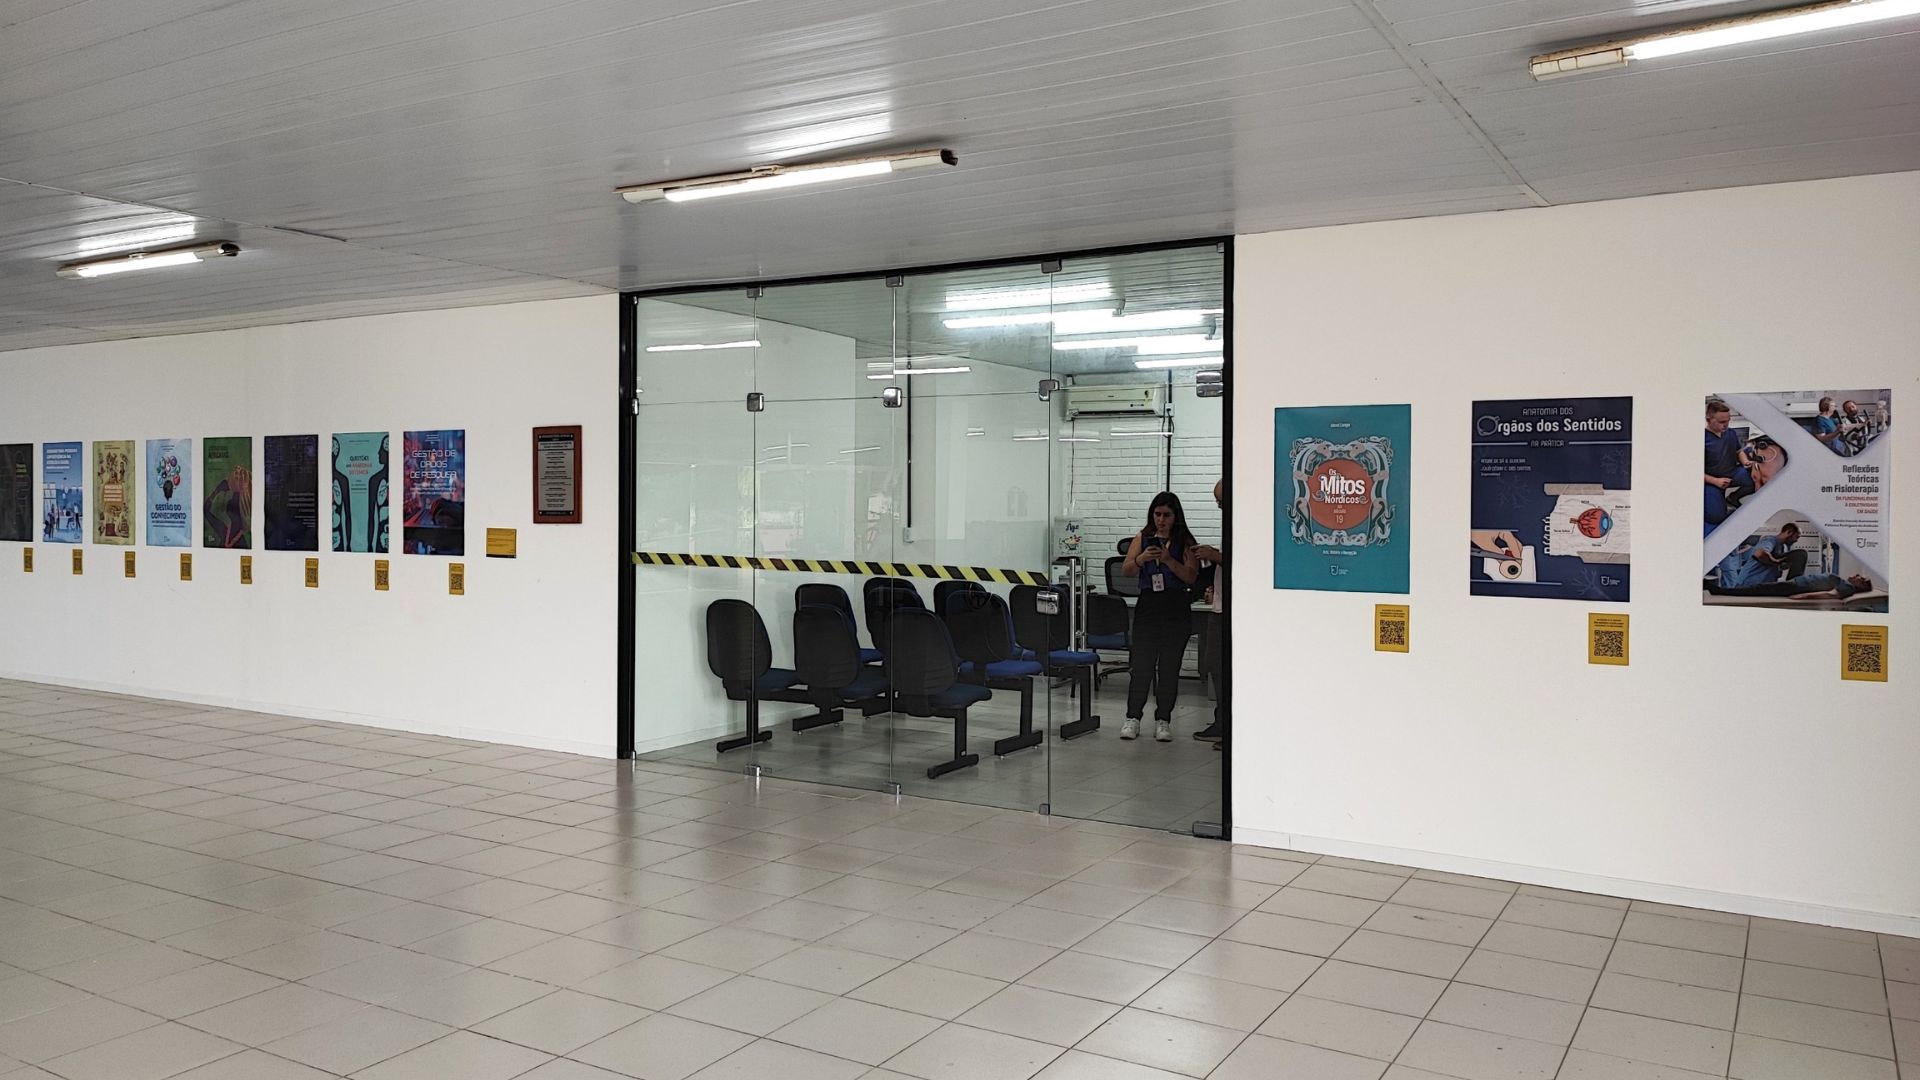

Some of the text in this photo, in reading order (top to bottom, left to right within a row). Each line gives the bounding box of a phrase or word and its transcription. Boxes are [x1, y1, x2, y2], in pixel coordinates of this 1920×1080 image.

[1522, 407, 1573, 416] ANATOMIA DOS
[1536, 418, 1560, 432] dos
[1563, 417, 1622, 432] Sentidos
[411, 447, 443, 458] GESTÃO
[420, 460, 448, 468] DADOS
[1842, 464, 1880, 473] Reflexões
[1328, 468, 1337, 476] Os
[1847, 474, 1880, 483] Teóricas
[1319, 475, 1366, 495] Mitos
[1834, 484, 1880, 495] Fisioterapia
[1324, 494, 1360, 504] Nórdicos
[1336, 514, 1344, 524] 19
